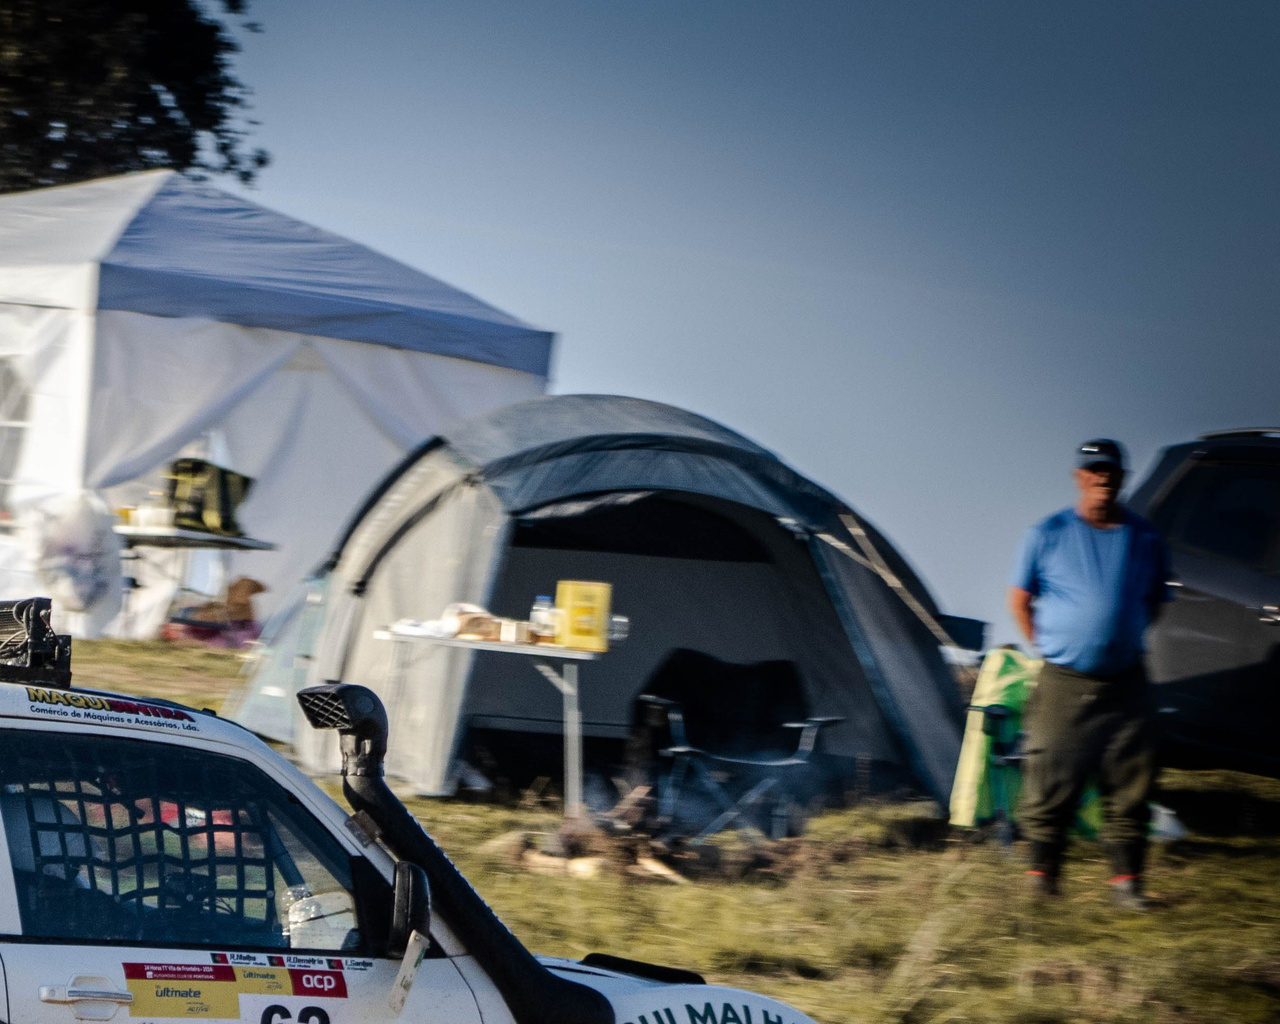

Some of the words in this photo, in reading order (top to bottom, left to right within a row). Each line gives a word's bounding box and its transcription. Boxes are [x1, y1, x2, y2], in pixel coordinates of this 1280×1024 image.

[30, 705, 69, 717] Comércio
[71, 710, 81, 718] de
[84, 712, 125, 723] Máquinas
[182, 723, 200, 732] Lda.
[302, 974, 336, 991] acp
[155, 987, 201, 998] ultimate
